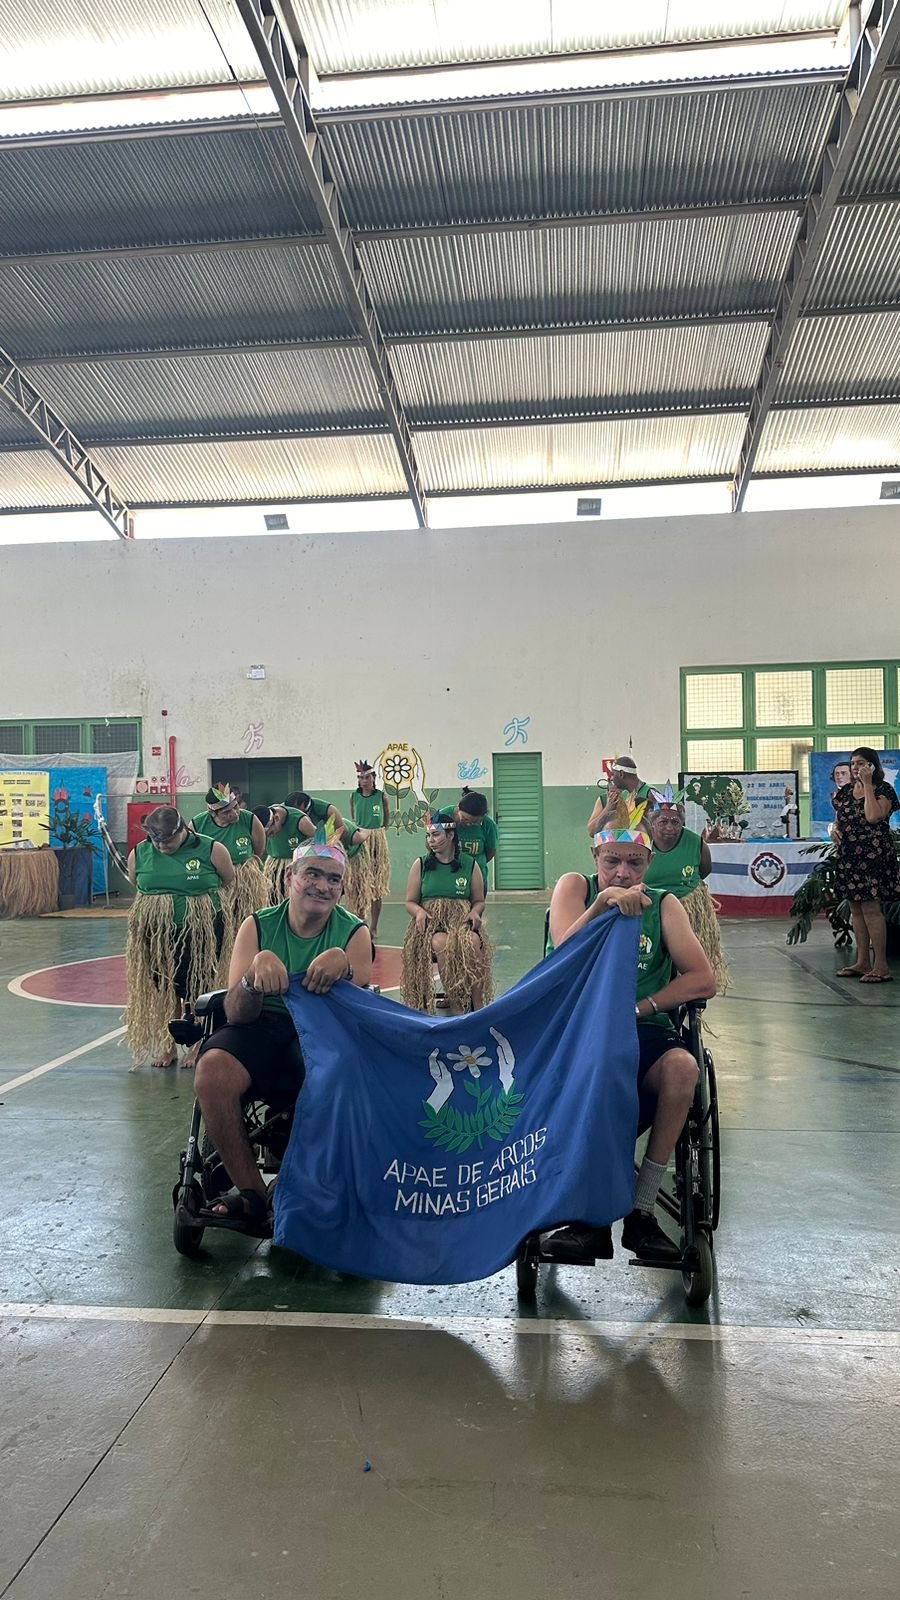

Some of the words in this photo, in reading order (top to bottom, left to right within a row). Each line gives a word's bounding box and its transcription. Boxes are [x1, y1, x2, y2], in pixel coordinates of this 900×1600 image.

[387, 743, 409, 751] APAE
[383, 1159, 447, 1187] APAE
[459, 1161, 484, 1185] DE
[489, 1127, 547, 1176] ARCOS
[395, 1189, 470, 1216] MINAS
[476, 1159, 537, 1208] GERAIS
